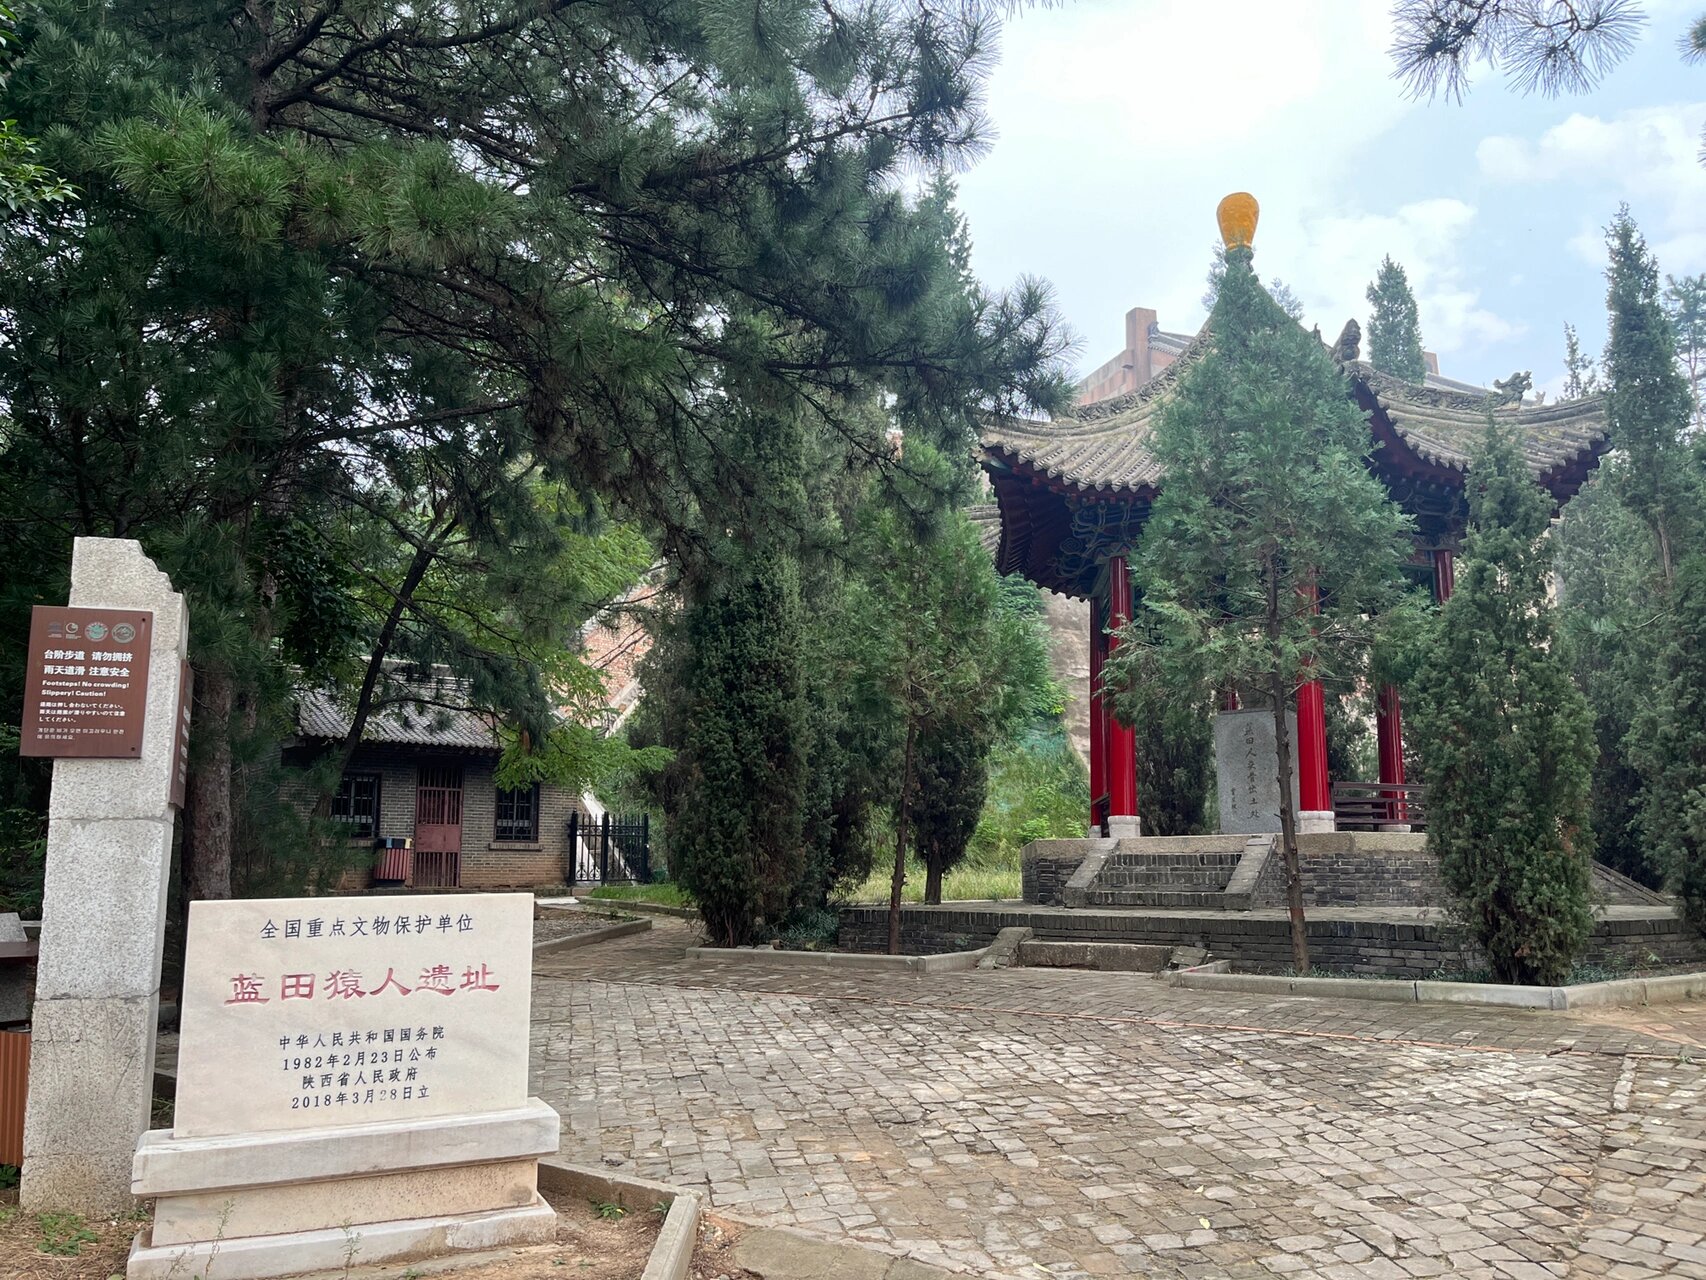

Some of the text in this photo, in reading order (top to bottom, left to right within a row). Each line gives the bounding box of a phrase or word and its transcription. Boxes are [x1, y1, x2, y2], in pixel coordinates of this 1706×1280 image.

[44, 649, 133, 663] 台阶步道 请勿拥挤
[43, 665, 130, 677] 雨天道滑 注意安全
[41, 680, 81, 688] Footsteps!
[93, 682, 130, 690] crowding!
[41, 689, 75, 697] Slippery!
[260, 914, 474, 940] 全国重点文物保护单位
[224, 962, 501, 1007] 蓝田猿人遗址
[279, 1025, 446, 1050] 中华人民共和国国务院
[283, 1046, 438, 1071] 1982年2月23日公布
[302, 1066, 419, 1090] 陕西省人民政府
[292, 1085, 431, 1110] 2018年3月28日立
